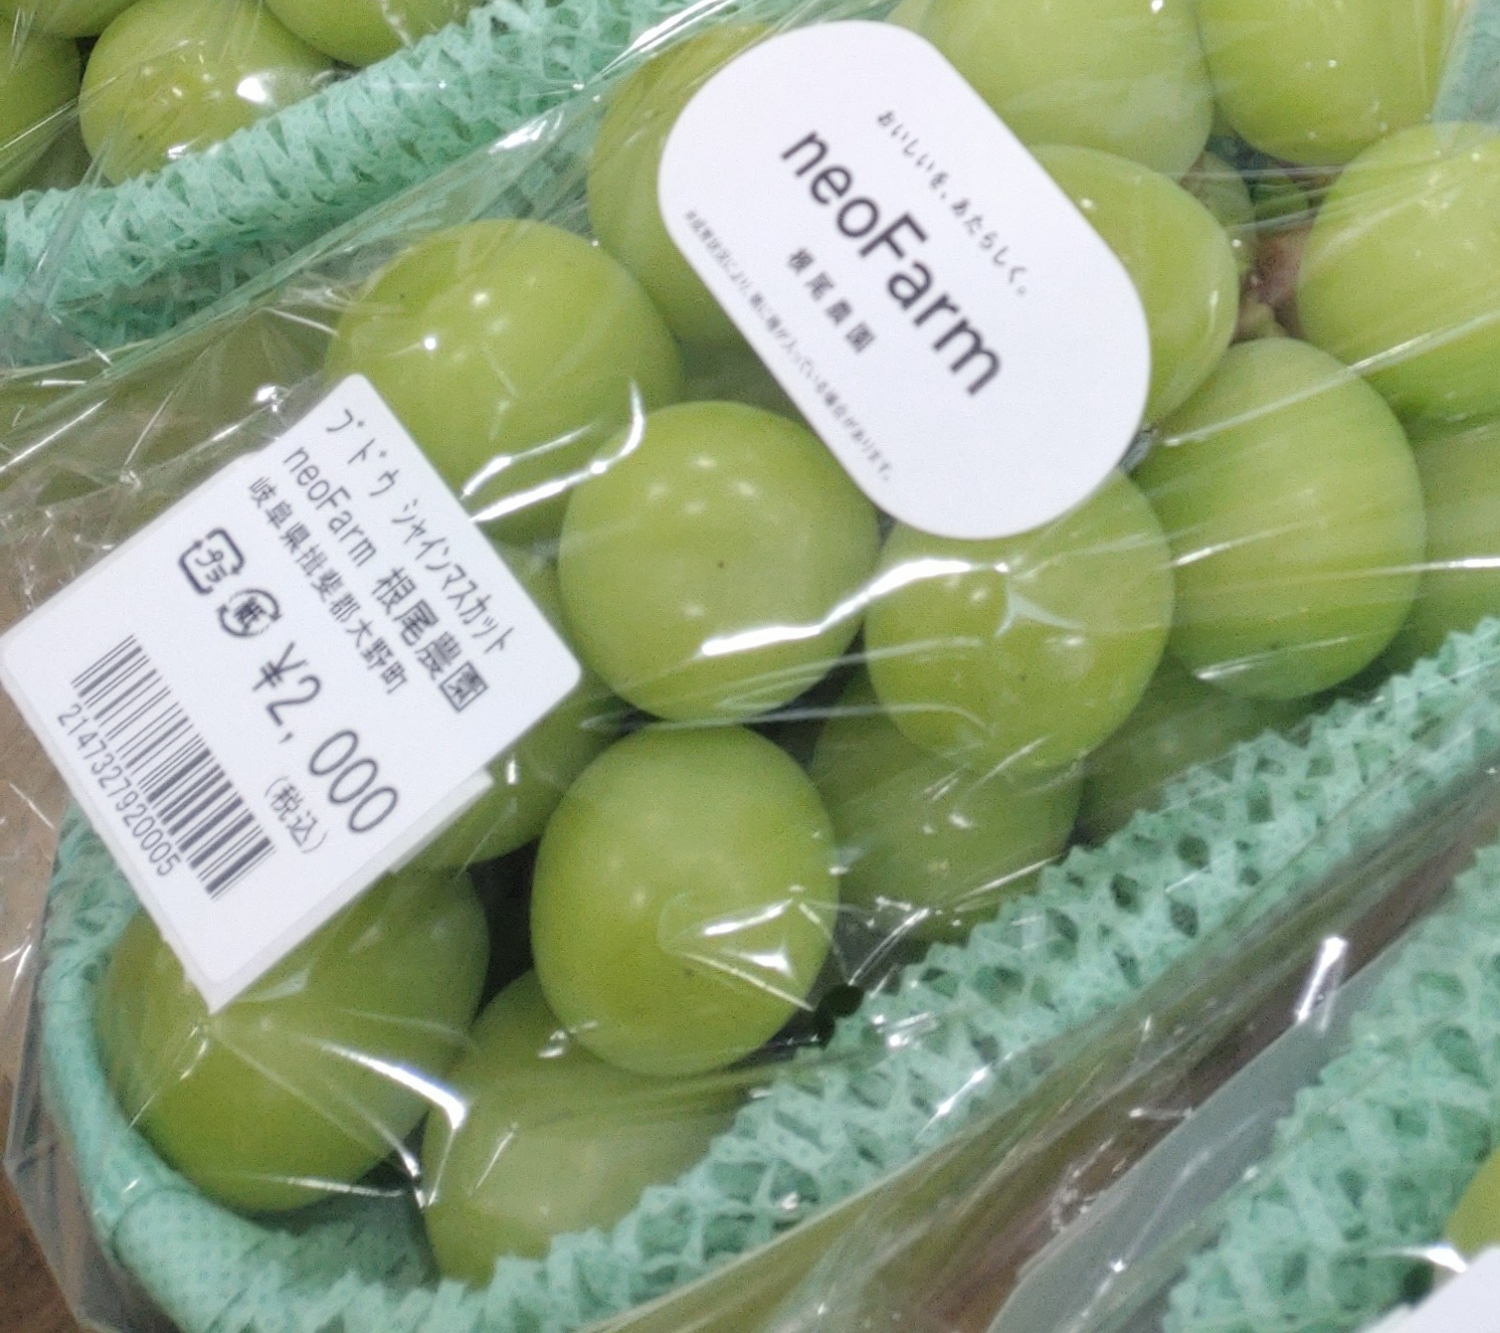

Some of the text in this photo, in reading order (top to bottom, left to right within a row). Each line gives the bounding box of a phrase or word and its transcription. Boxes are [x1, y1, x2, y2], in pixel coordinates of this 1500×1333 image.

[780, 130, 1003, 398] neoFarm
[877, 108, 1029, 297] おいしいを、あたらしく。
[248, 475, 412, 696] 岐阜県揖斐郡大野町
[282, 445, 490, 715] neoFarm 根尾農園
[325, 406, 516, 657] ブドウ シャインマスカット
[55, 703, 181, 879] 2147327920005
[251, 642, 401, 834] ¥2,000
[264, 775, 331, 855] (税込)
